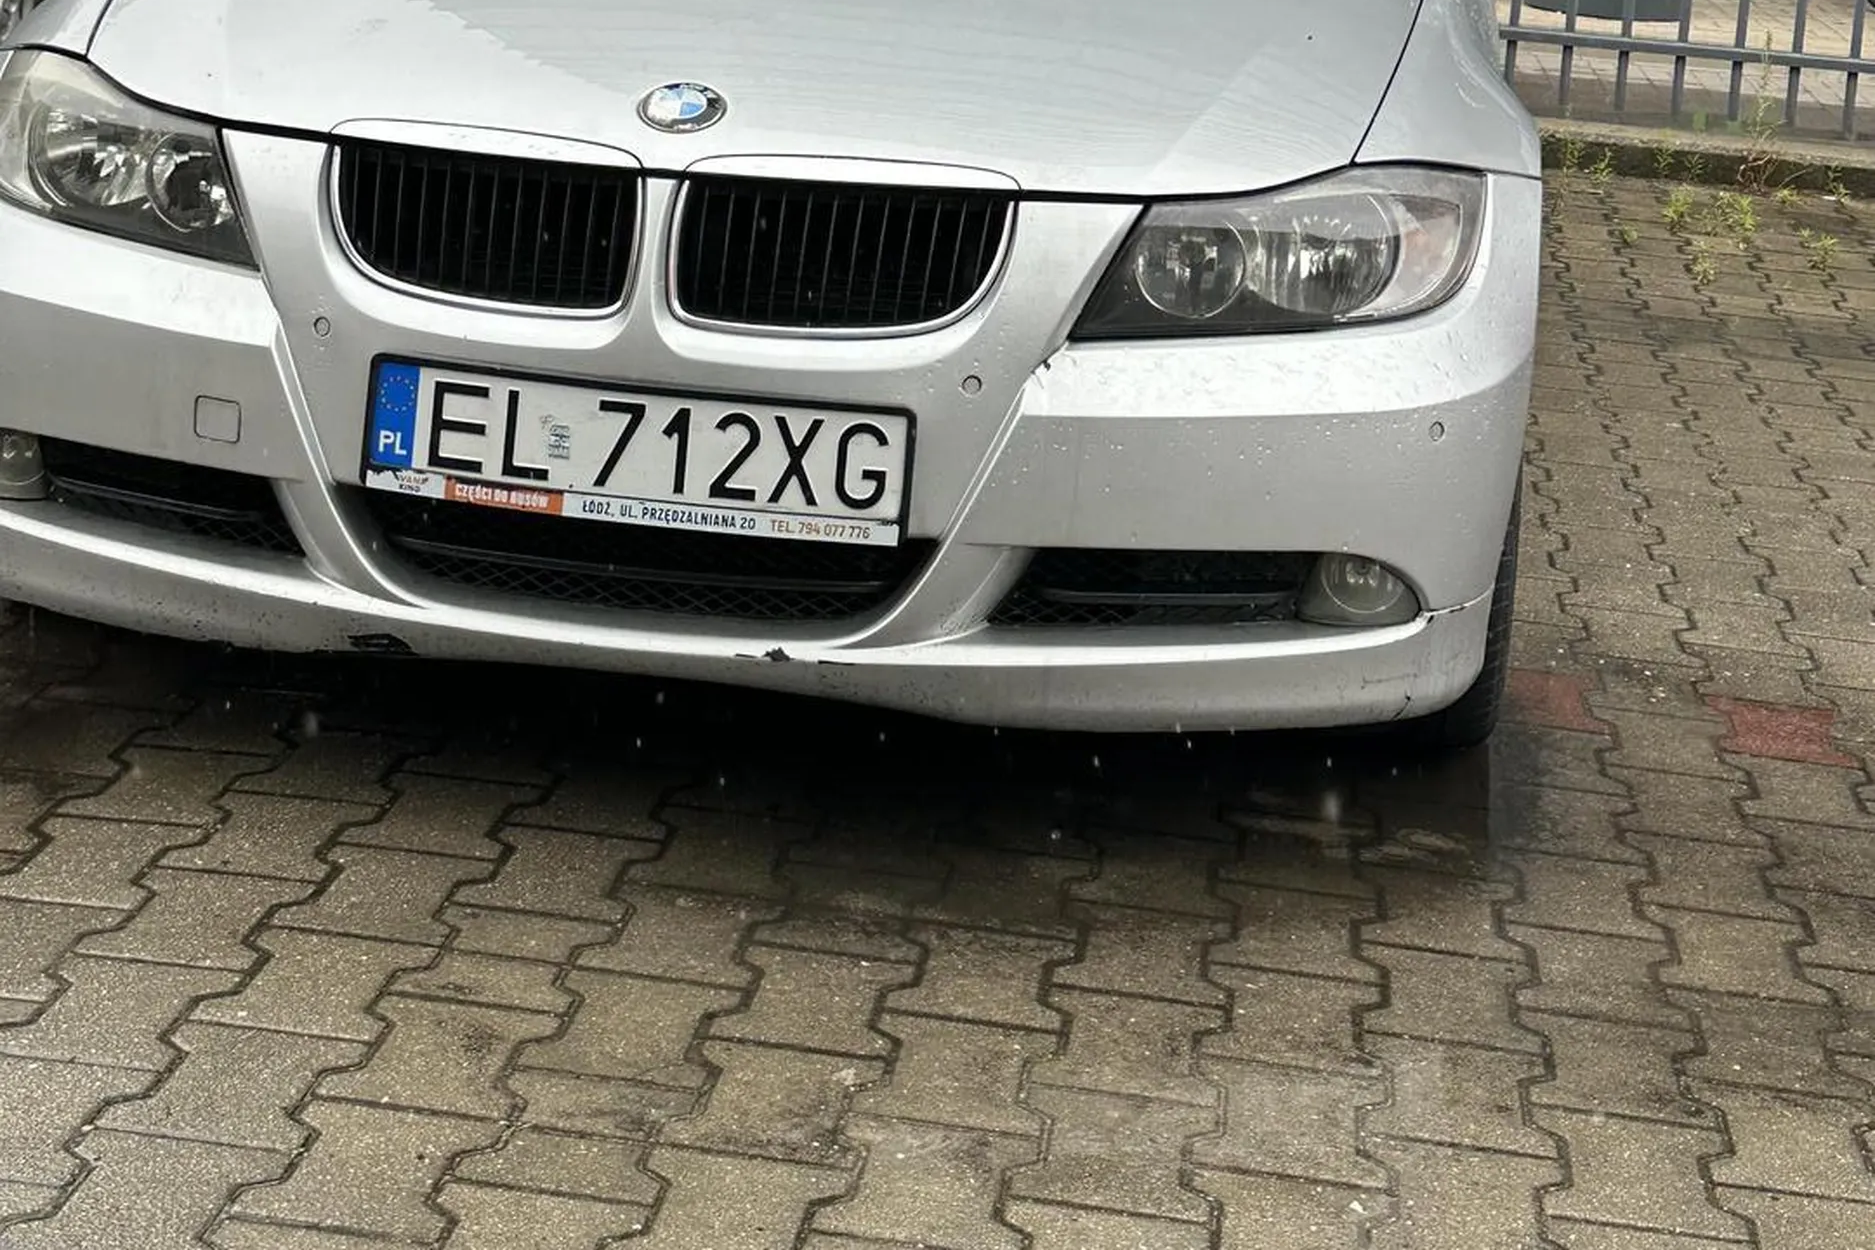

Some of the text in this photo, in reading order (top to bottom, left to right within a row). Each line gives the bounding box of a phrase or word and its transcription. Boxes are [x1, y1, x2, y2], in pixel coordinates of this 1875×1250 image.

[378, 429, 407, 455] PL
[428, 379, 891, 511] EL 712XG
[620, 503, 638, 519] UL.
[641, 506, 737, 529] PRZĘDZALNIANA
[739, 517, 756, 530] 20
[797, 521, 821, 536] 794
[823, 523, 847, 538] 077
[848, 525, 872, 540] 776
